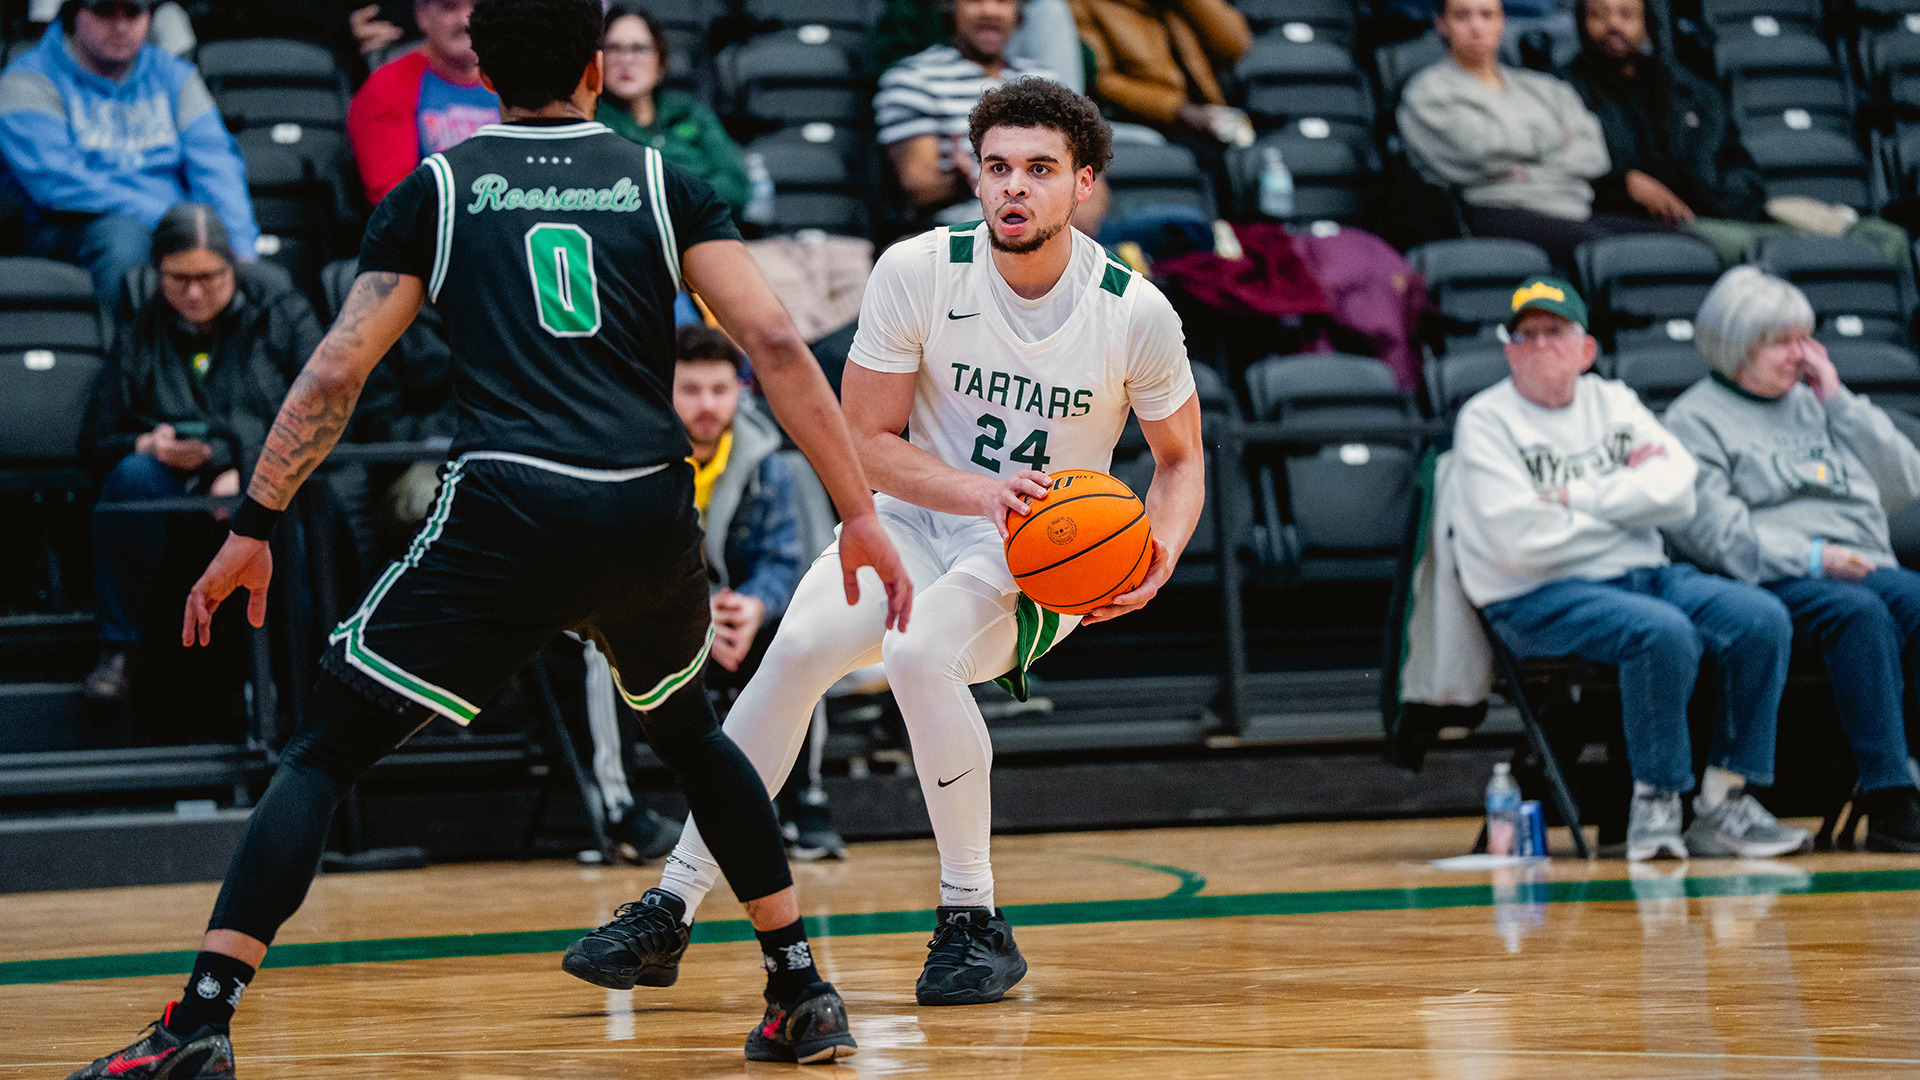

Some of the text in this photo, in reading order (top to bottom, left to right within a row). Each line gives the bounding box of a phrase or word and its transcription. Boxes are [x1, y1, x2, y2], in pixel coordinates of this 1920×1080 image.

[467, 173, 642, 214] Roosevelt
[524, 222, 602, 338] 0
[951, 362, 1093, 419] TARTARS
[970, 412, 1051, 474] 24
